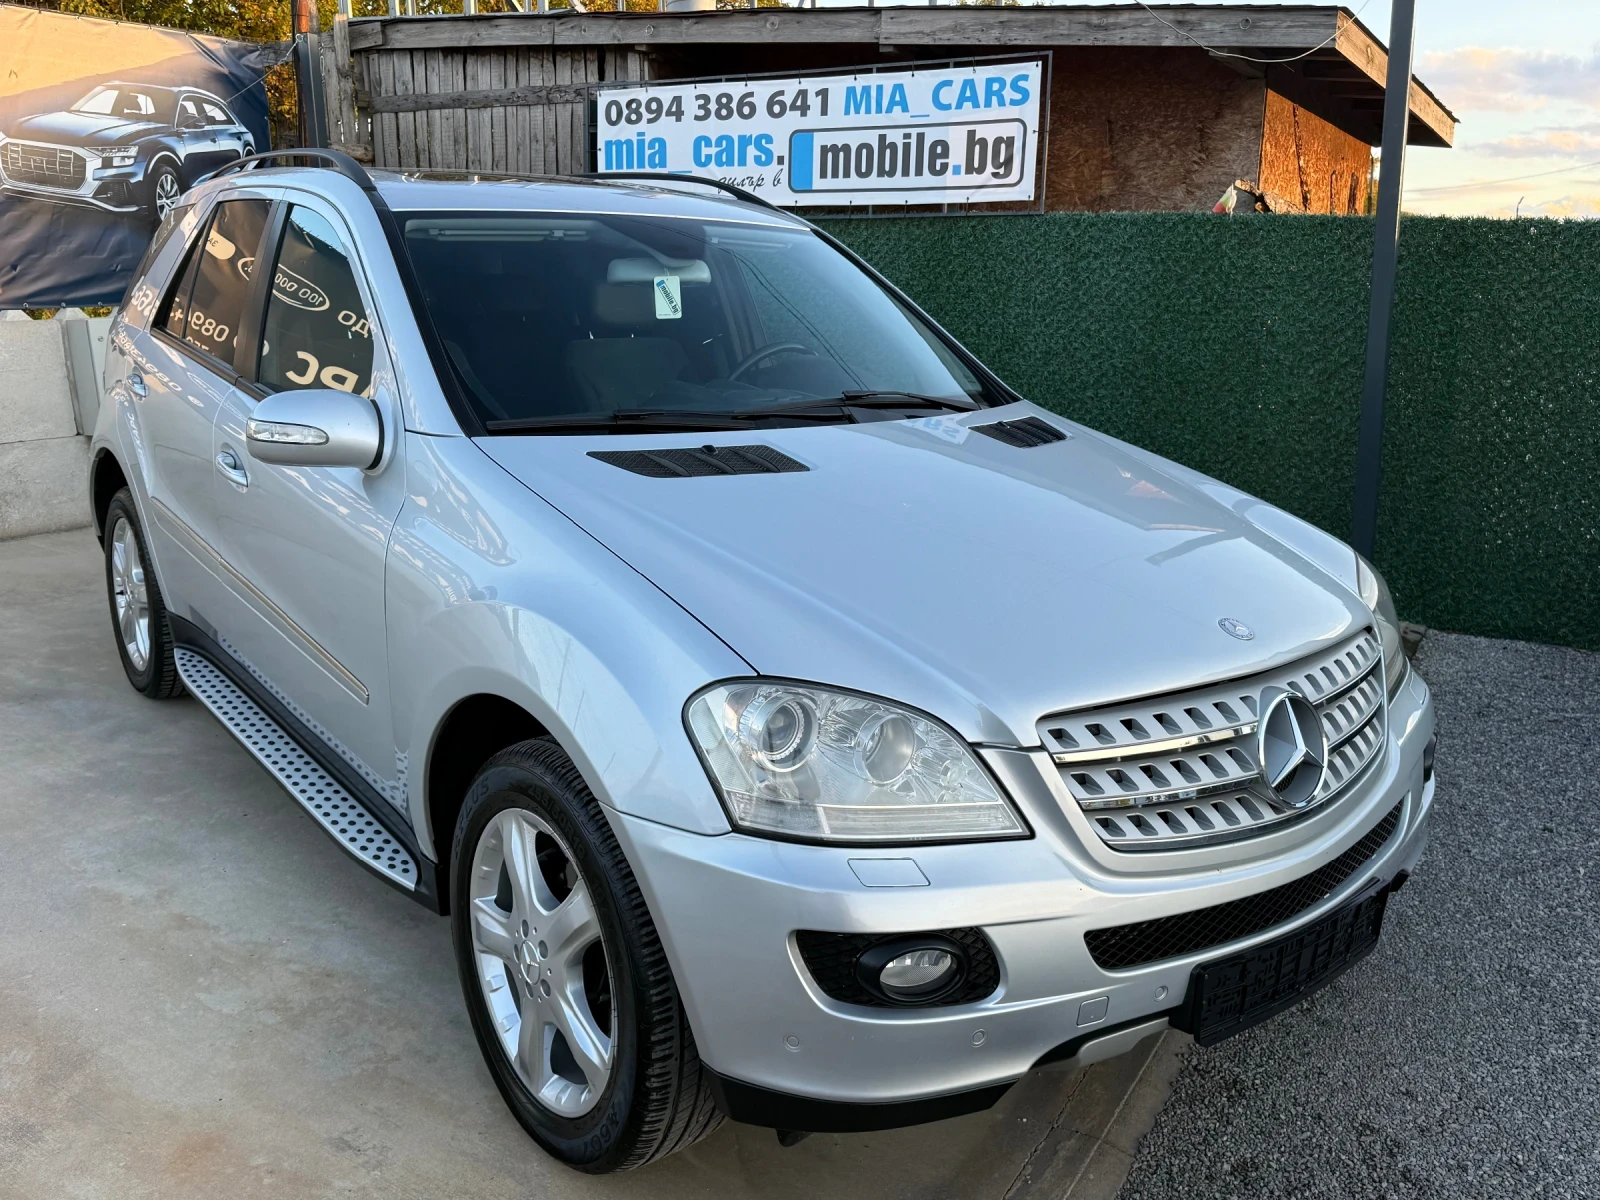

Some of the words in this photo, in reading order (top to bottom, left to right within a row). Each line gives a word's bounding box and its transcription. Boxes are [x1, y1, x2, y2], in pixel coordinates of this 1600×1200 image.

[604, 95, 684, 126] 0894
[693, 91, 757, 121] 386
[766, 88, 829, 119] 641
[844, 74, 1030, 118] MIA_CARS
[820, 129, 1015, 179] mobile.bg
[659, 285, 679, 314] mobile.bg
